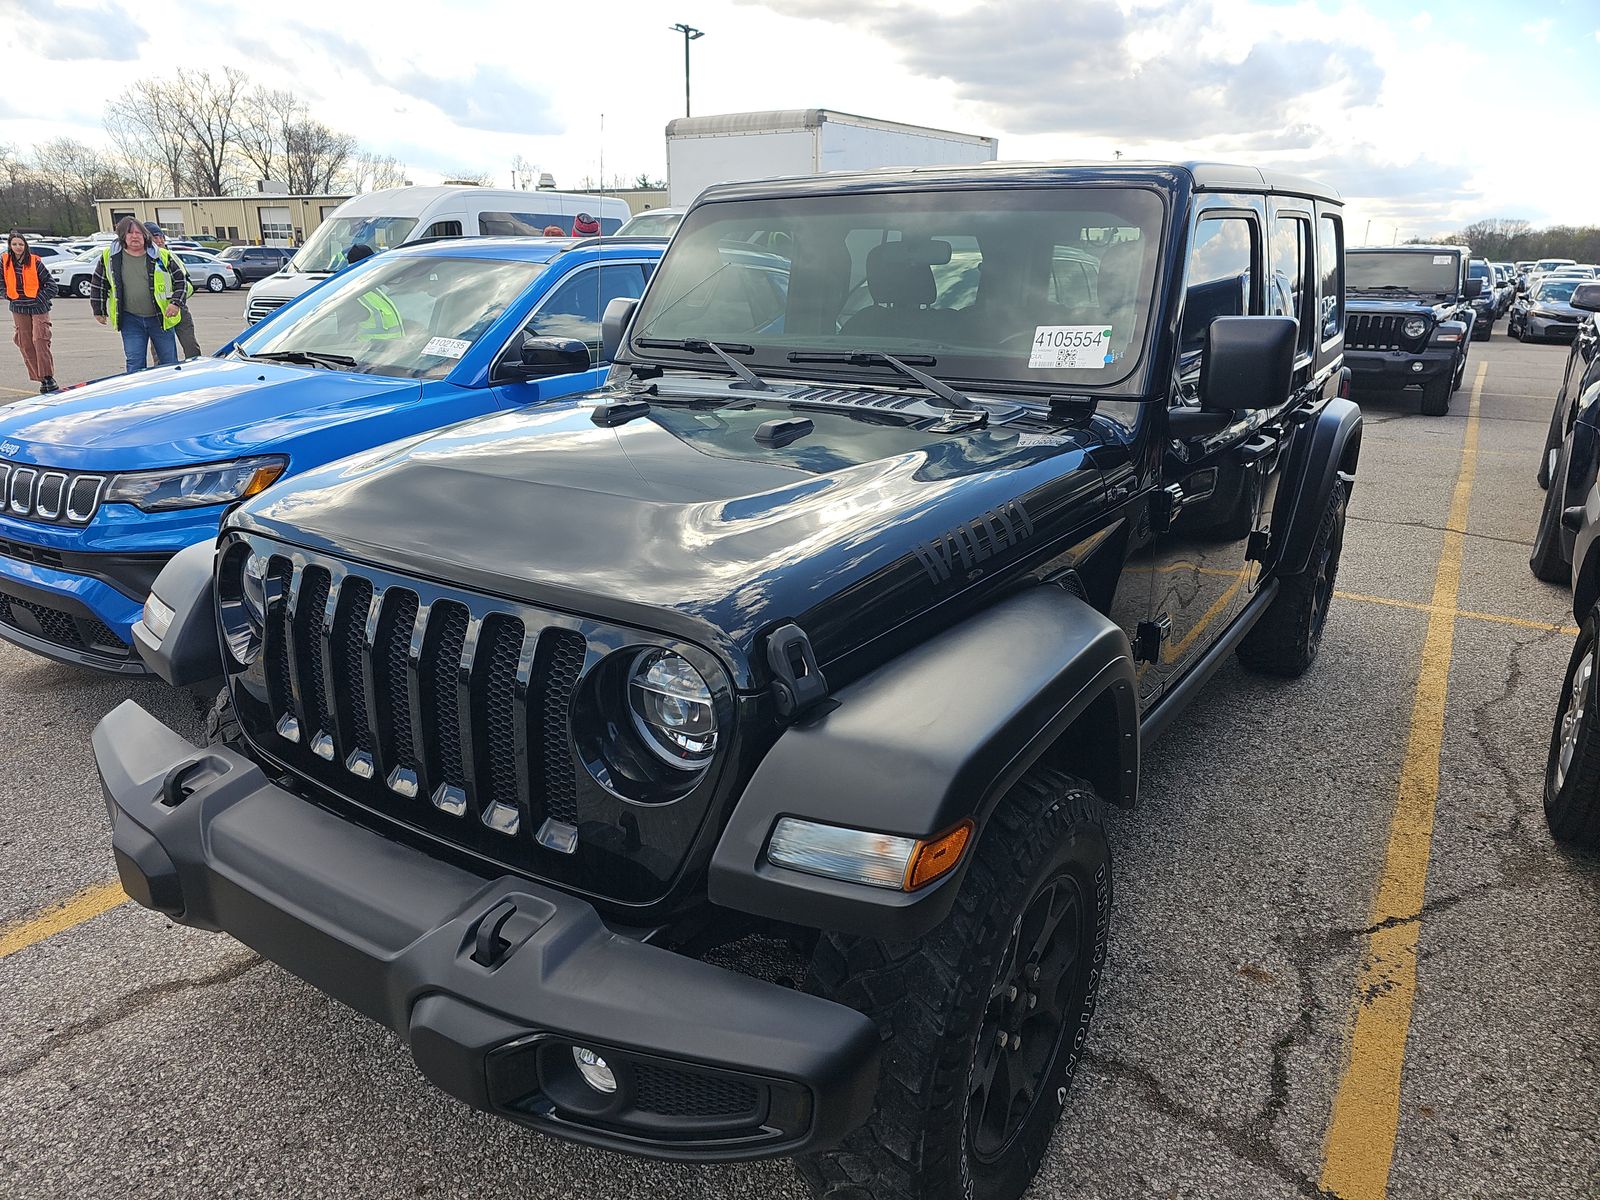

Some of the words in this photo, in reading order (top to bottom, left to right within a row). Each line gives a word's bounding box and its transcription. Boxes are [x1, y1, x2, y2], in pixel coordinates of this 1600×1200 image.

[430, 338, 466, 350] 4102135
[1035, 331, 1102, 348] 4105554
[0, 440, 20, 456] Jeep
[1064, 862, 1106, 1078] DESTINATION
